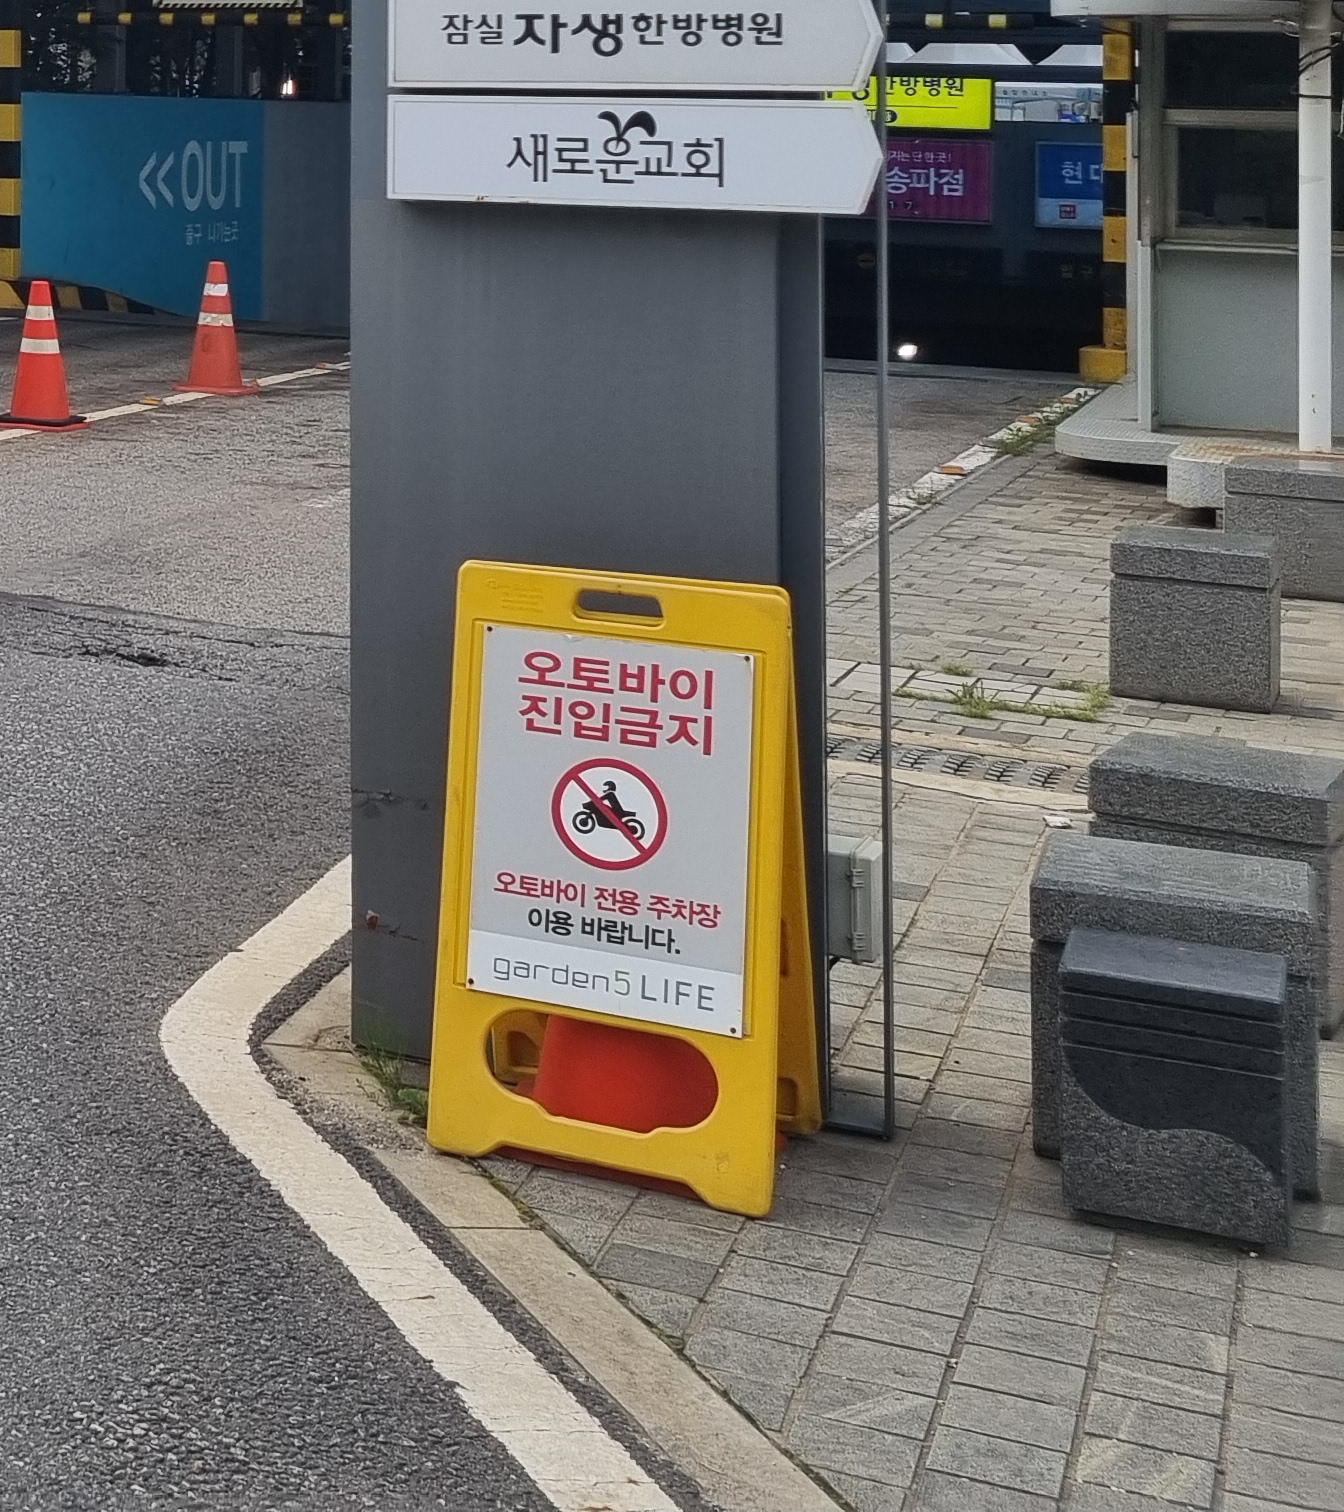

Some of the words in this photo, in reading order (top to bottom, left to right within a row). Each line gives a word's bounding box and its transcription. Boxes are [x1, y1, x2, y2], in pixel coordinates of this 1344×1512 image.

[441, 13, 504, 46] 잠실
[181, 140, 249, 212] OUT
[506, 120, 725, 187] 새로운교회
[885, 167, 964, 196] 송파점
[518, 650, 714, 709] 오토바이
[518, 694, 714, 756] 진입금지
[494, 871, 585, 907] 오토바이
[593, 887, 641, 916] 전용
[647, 894, 721, 929] 주차장
[528, 908, 574, 936] 이용
[581, 916, 681, 954] 바랍니다.
[641, 975, 714, 1012] LIFE
